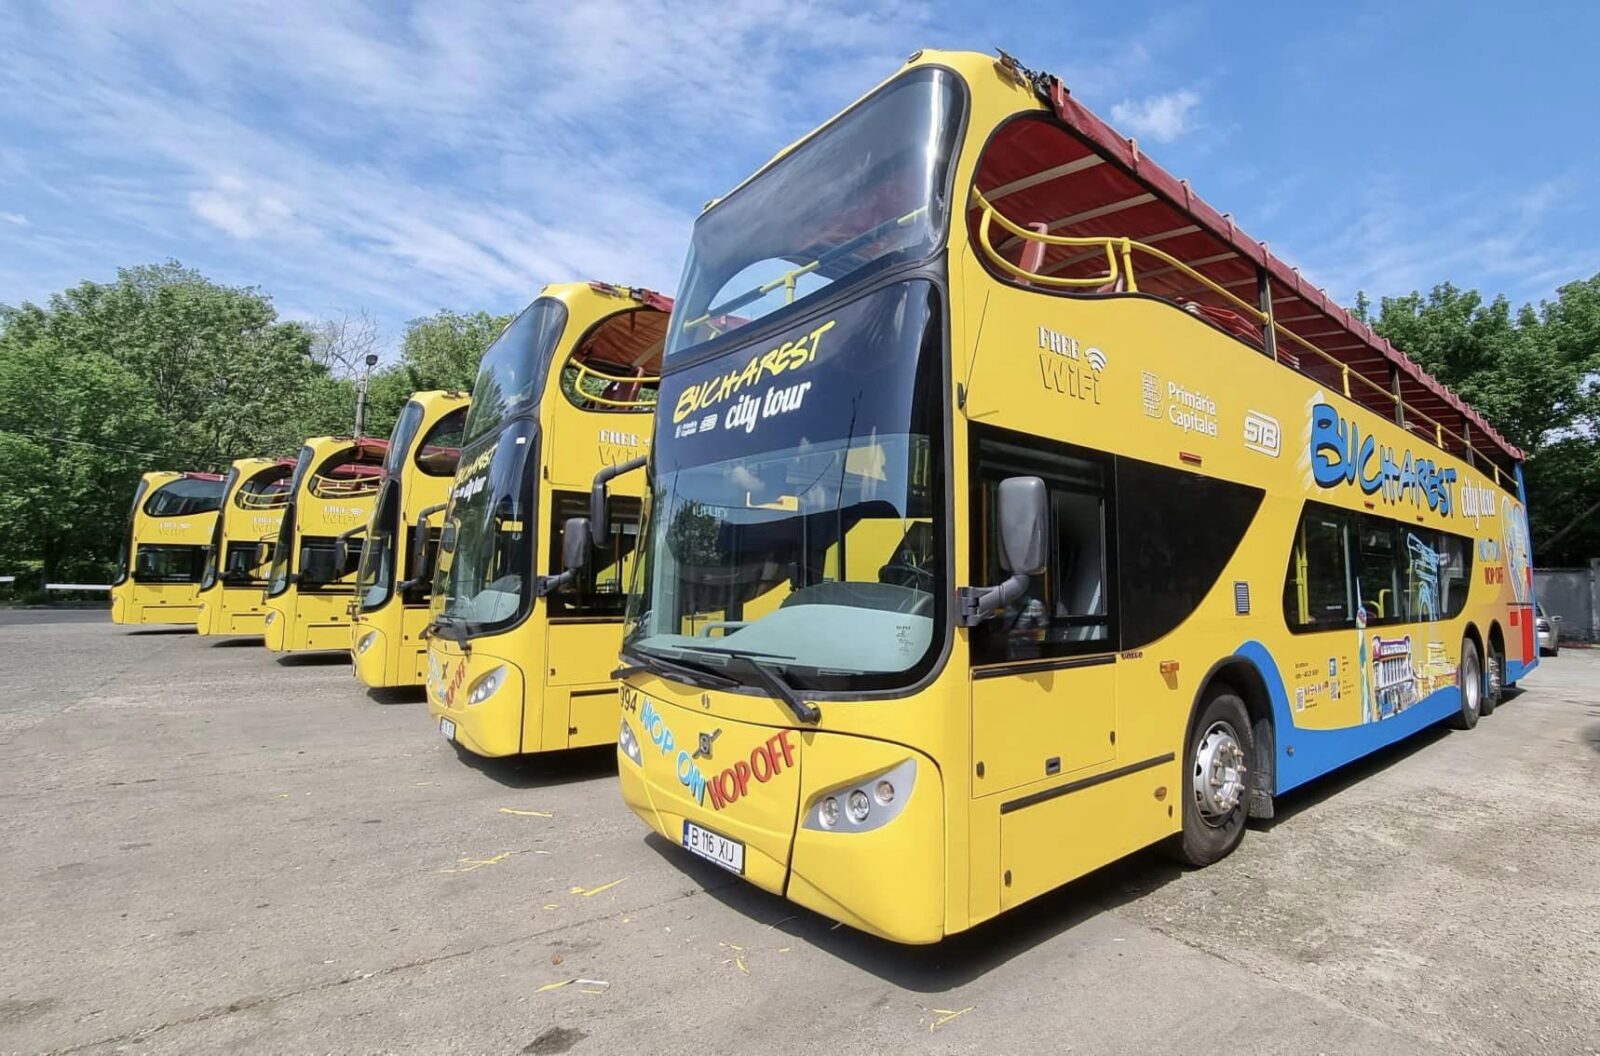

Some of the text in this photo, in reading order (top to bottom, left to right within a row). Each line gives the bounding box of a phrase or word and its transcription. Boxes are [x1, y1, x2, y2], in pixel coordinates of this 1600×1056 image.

[1038, 326, 1081, 362] FREE
[673, 320, 836, 424] BUCHAREST
[725, 395, 760, 433] city
[762, 381, 812, 418] tour
[1168, 381, 1216, 417] Primăria
[1168, 404, 1218, 438] Capitalei
[1244, 415, 1279, 449] STB
[1311, 403, 1457, 519] BUCHAREST
[640, 695, 706, 808] HOP ON
[706, 728, 796, 811] HOP OFF
[691, 827, 735, 863] B 116 XIJ
